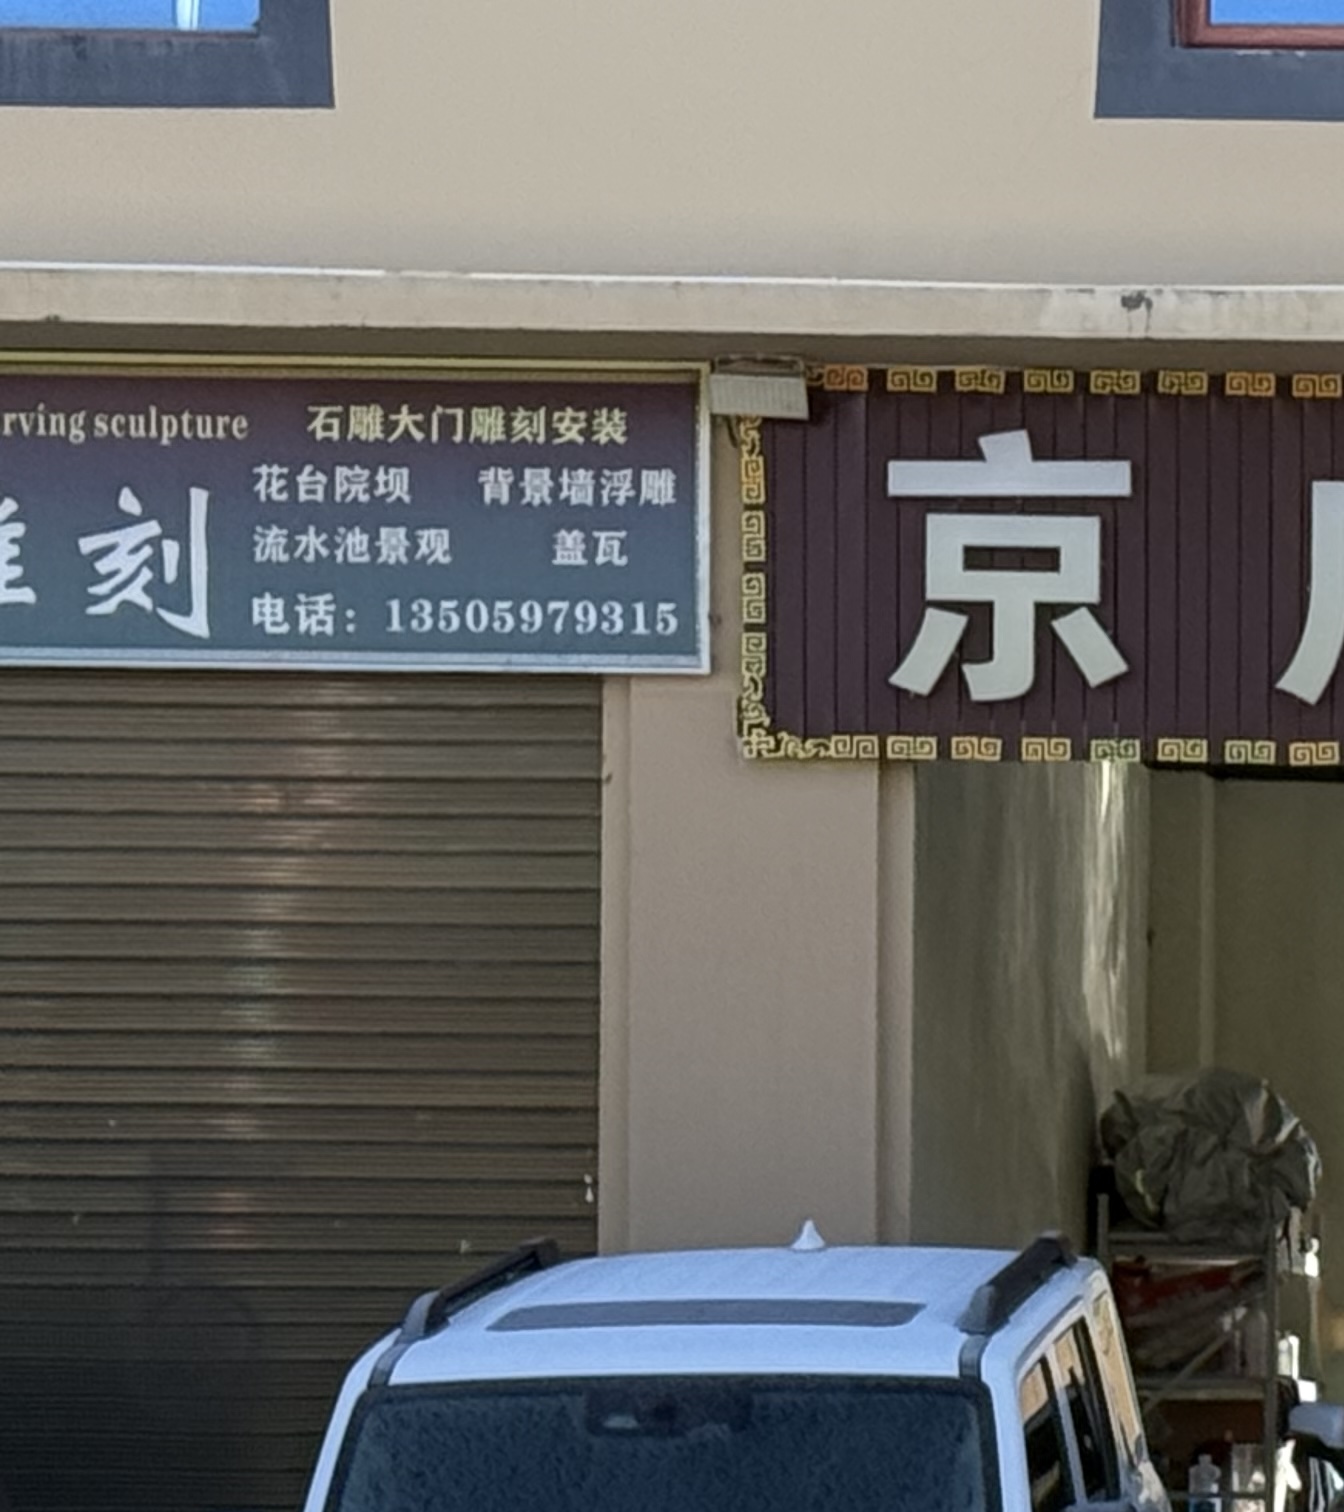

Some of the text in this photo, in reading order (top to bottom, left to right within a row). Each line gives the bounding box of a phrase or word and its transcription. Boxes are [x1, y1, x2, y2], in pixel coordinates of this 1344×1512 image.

[93, 404, 249, 446] sculpture
[306, 403, 629, 446] 石雕大门雕刻安装
[252, 464, 678, 507] 花台院坝 背景墙浮雕
[252, 525, 629, 567] 流水池景观 盖瓦
[385, 599, 679, 636] 13505979315
